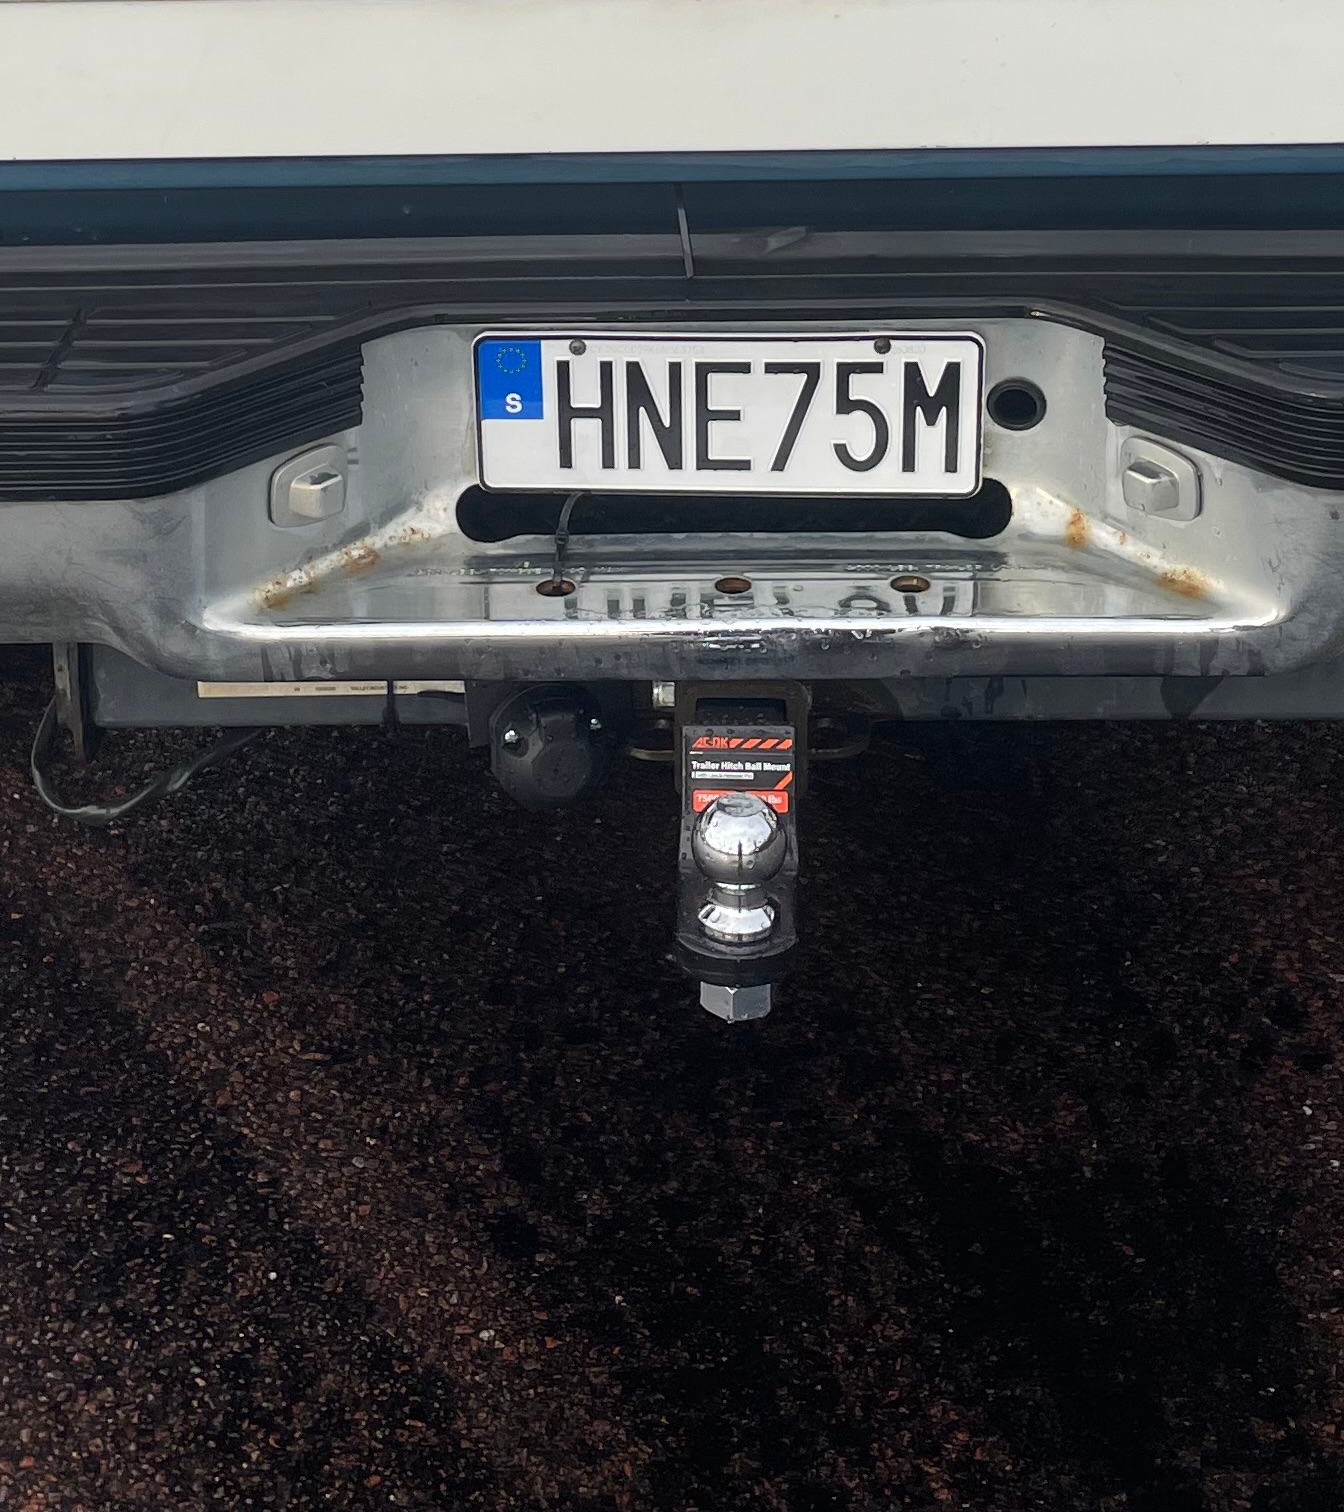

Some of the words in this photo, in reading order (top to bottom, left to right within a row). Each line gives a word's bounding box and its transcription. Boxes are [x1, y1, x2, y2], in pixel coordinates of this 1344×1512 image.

[504, 392, 524, 414] S
[555, 359, 962, 474] HNE75M
[691, 760, 719, 770] Trailer
[720, 761, 744, 771] Hitch
[744, 762, 762, 771] Ball
[763, 762, 791, 772] Mount
